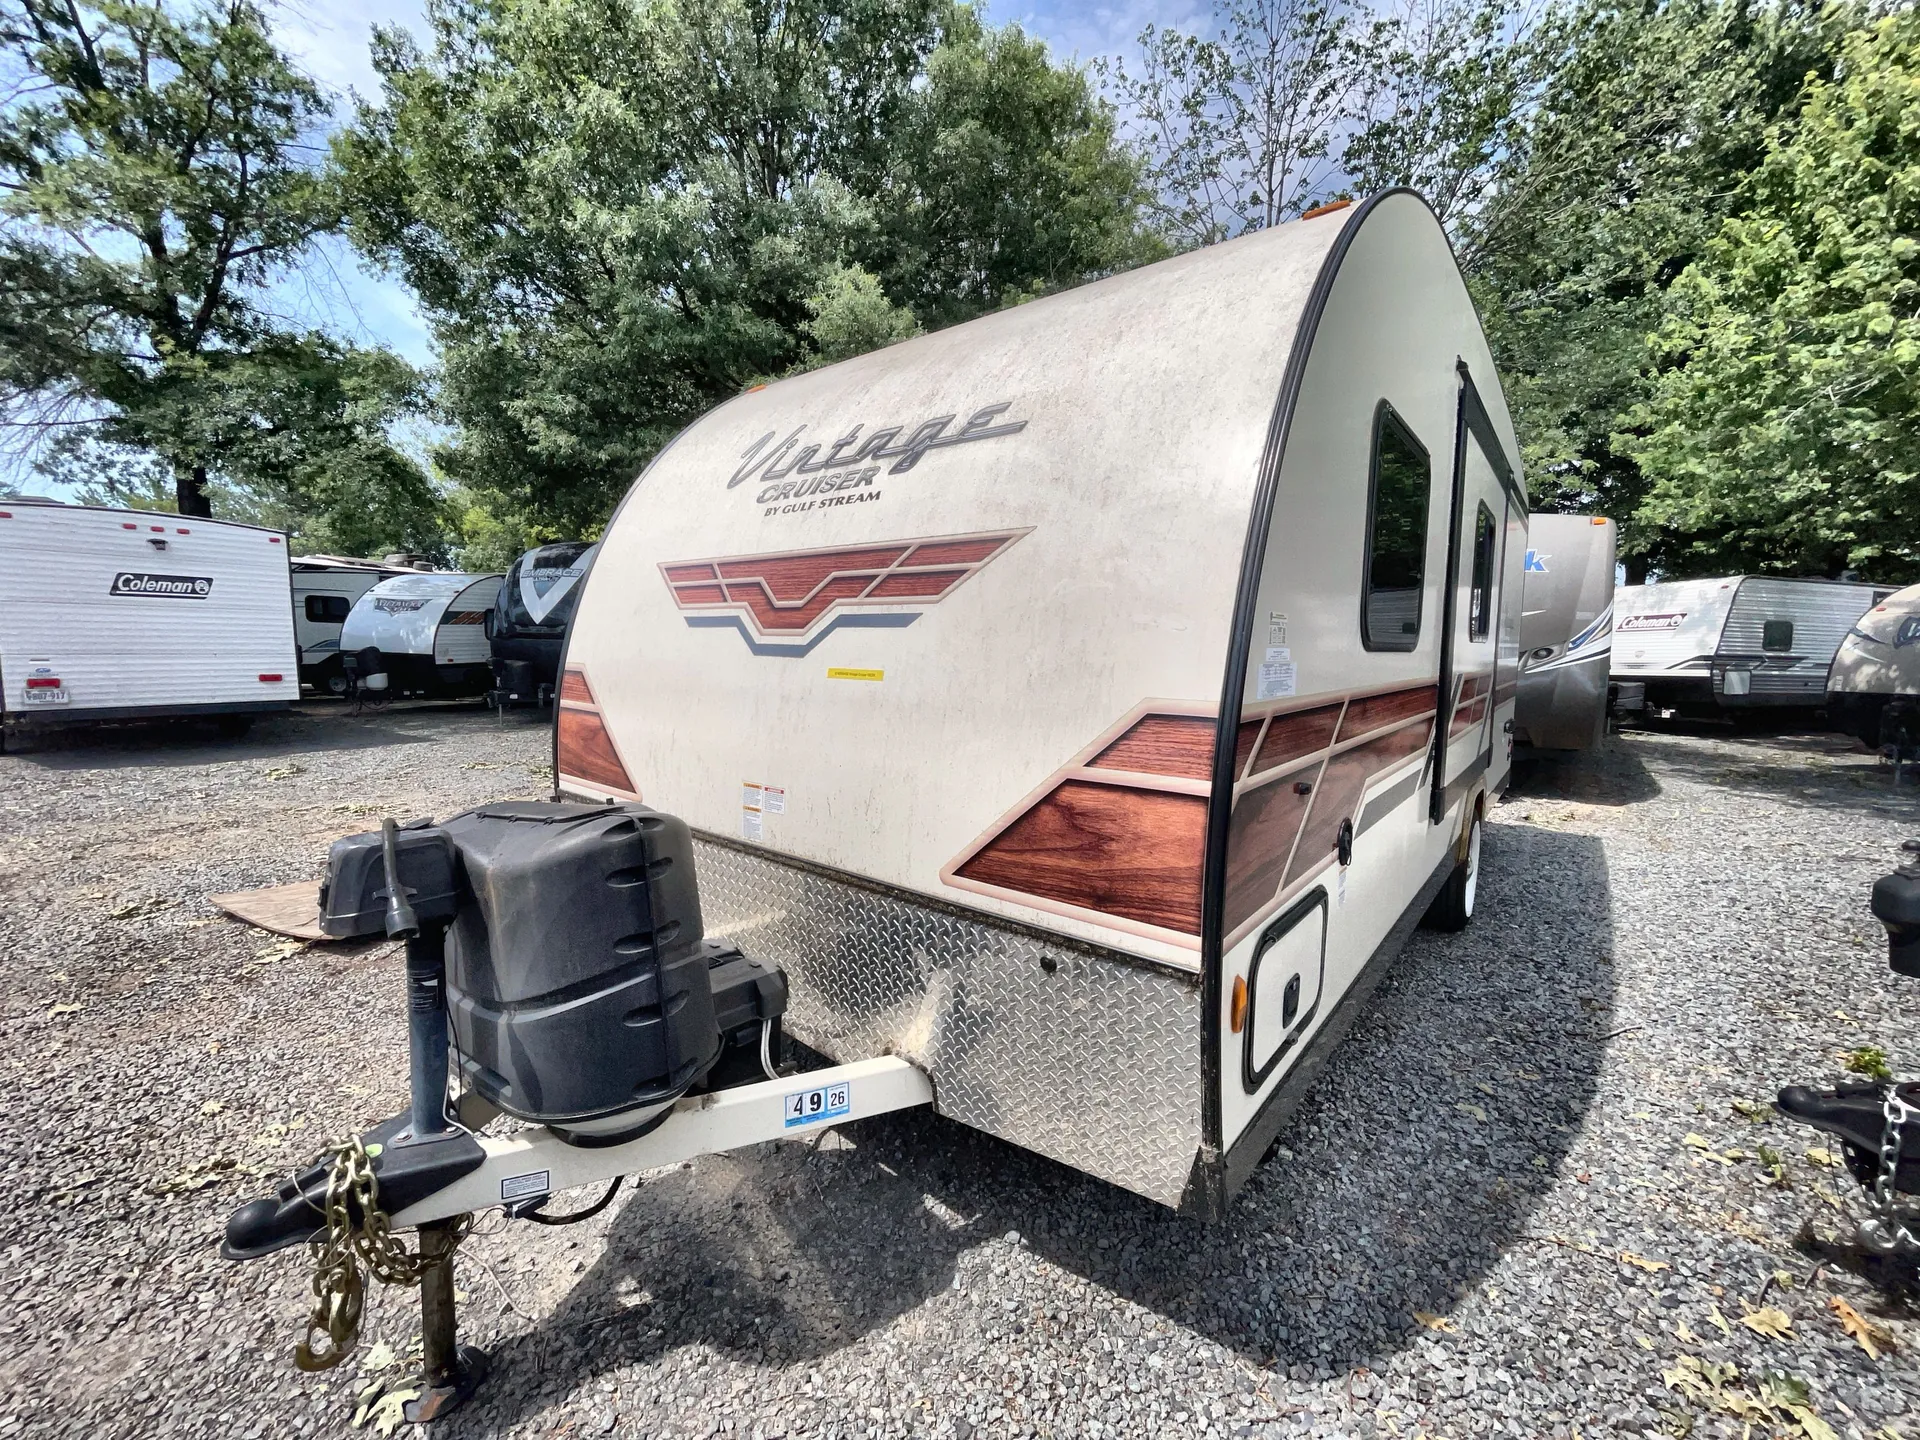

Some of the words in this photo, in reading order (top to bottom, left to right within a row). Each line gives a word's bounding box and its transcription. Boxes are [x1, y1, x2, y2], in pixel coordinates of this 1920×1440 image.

[727, 402, 1028, 489] Vintage
[756, 466, 881, 504] CRUISER
[764, 506, 780, 517] BY
[782, 501, 816, 514] GULF
[818, 491, 881, 508] STREAM
[521, 568, 583, 578] EMBRACE
[118, 574, 193, 593] Coleman
[1621, 616, 1671, 628] Coleman
[830, 1091, 845, 1107] 26
